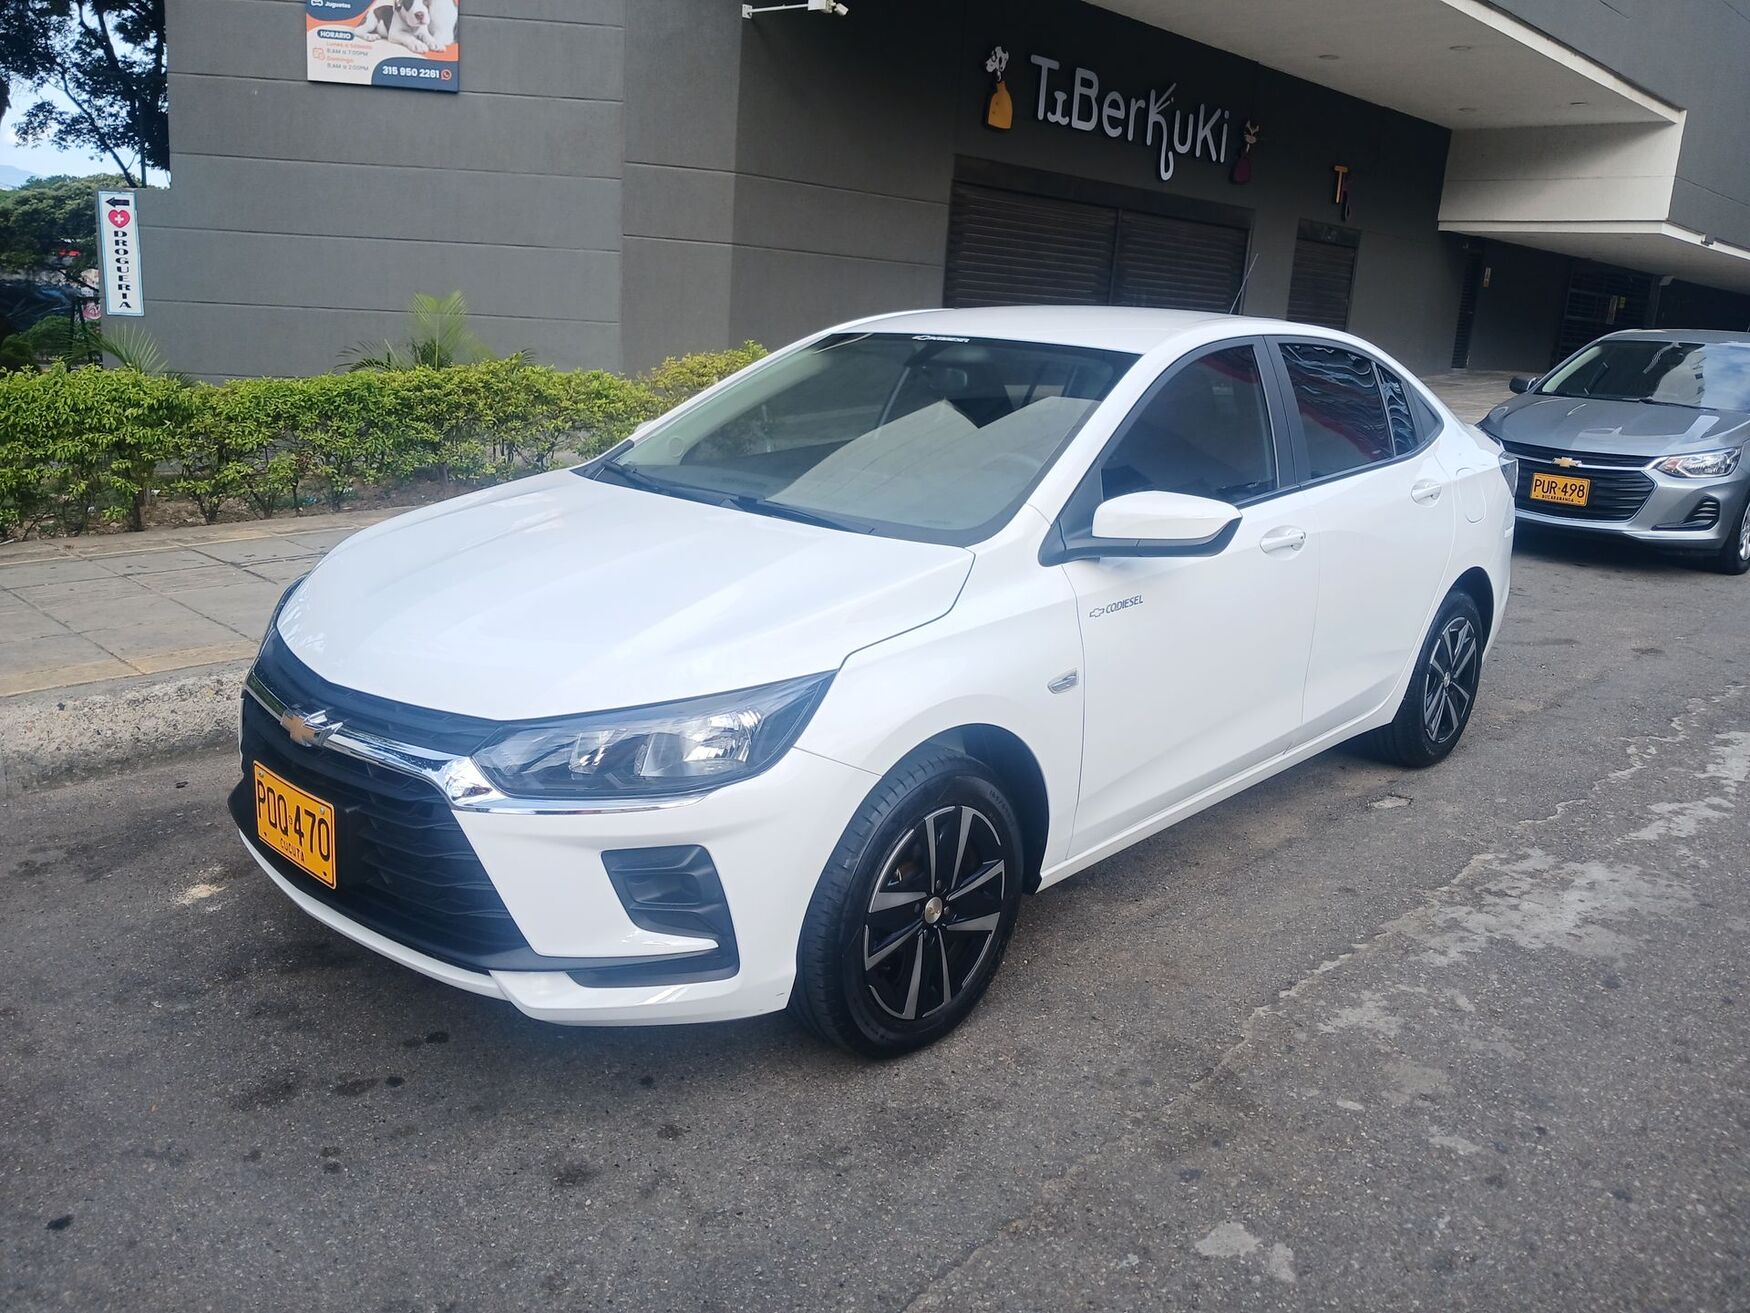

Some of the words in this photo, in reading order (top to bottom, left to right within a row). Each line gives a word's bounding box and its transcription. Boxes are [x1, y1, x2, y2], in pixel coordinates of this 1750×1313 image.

[320, 31, 352, 39] HORARIO
[382, 65, 398, 75] 315
[399, 67, 418, 76] 950
[113, 230, 132, 309] DROGUERIA
[1533, 478, 1557, 495] PUR
[1561, 483, 1585, 499] 498
[1105, 594, 1144, 614] CODIESEL
[293, 804, 331, 862] 470
